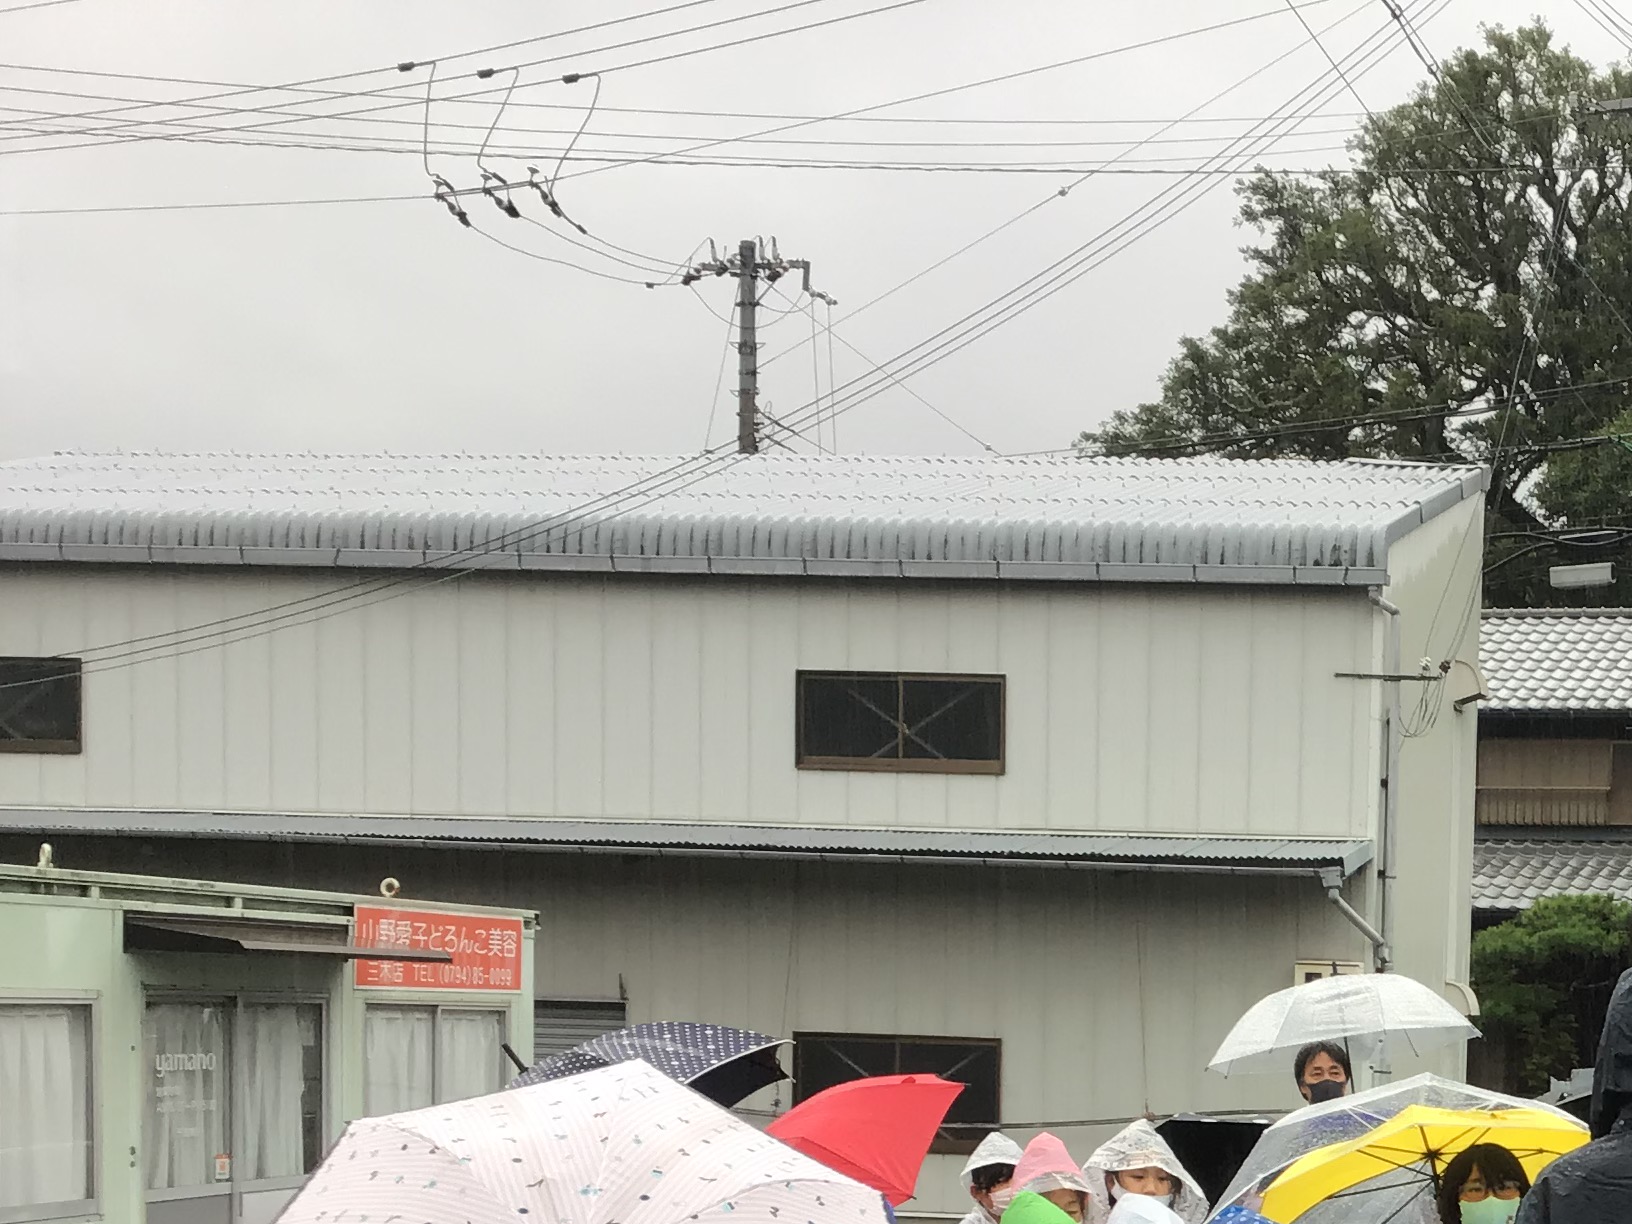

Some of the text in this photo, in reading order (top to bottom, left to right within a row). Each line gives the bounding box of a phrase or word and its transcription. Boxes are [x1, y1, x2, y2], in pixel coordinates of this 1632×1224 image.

[367, 961, 404, 983] 三木店
[413, 964, 435, 982] TEL
[155, 1053, 217, 1078] yamano
